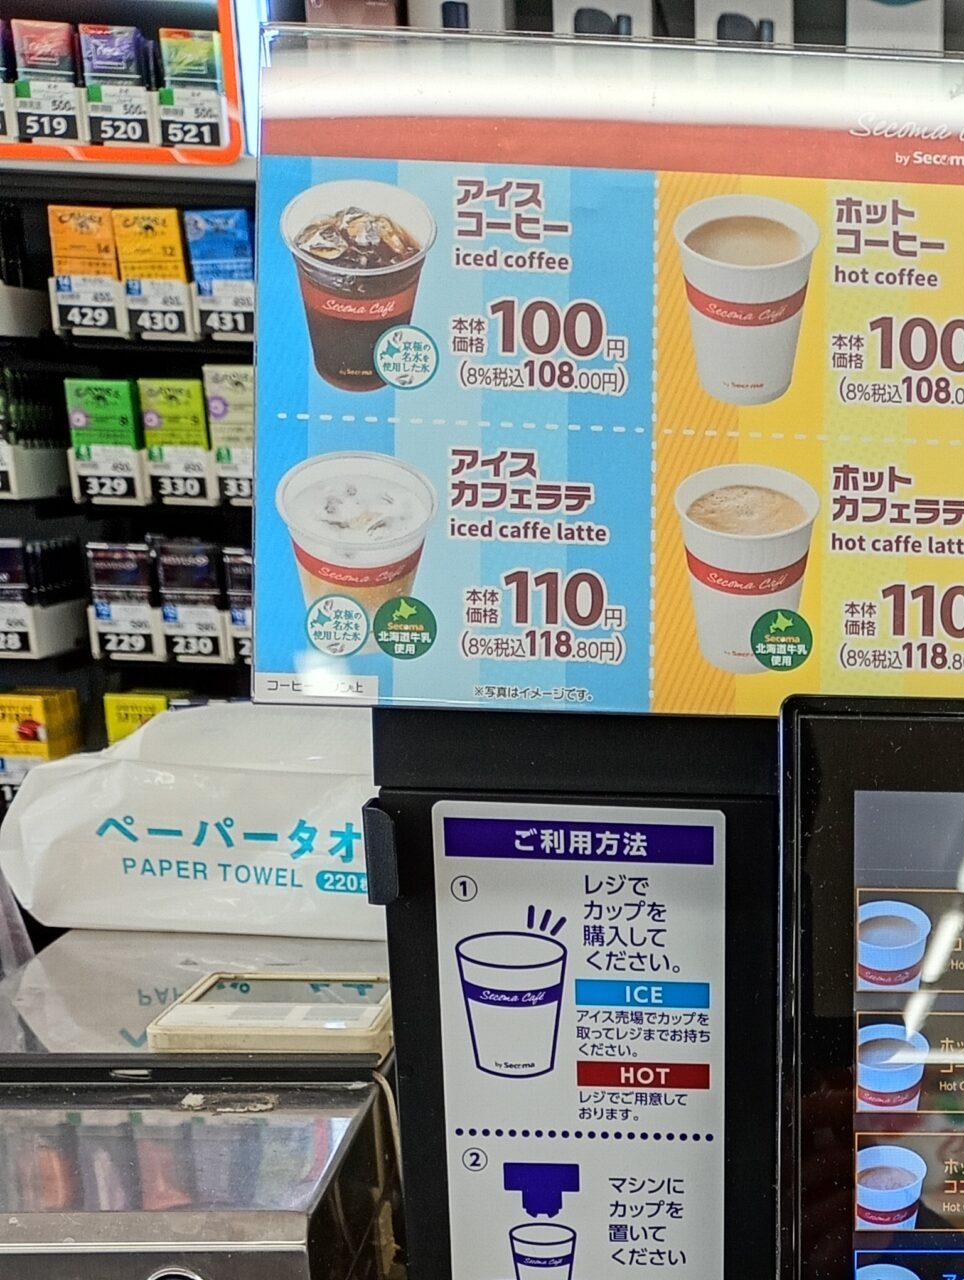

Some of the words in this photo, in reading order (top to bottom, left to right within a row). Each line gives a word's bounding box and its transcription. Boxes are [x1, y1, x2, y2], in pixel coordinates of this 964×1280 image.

[26, 117, 67, 135] 519
[101, 121, 141, 139] 520
[168, 124, 212, 143] 521
[850, 112, 952, 140] Secoma
[896, 153, 910, 165] by
[457, 179, 542, 208] アイス
[836, 198, 915, 225] ホット
[457, 211, 569, 240] コーヒー
[836, 229, 945, 257] コーヒー
[455, 248, 498, 267] iced
[504, 249, 570, 271] coffee
[834, 266, 869, 284] hot
[875, 268, 938, 286] coffee
[67, 308, 108, 326] 429
[137, 312, 179, 329] 430
[206, 313, 245, 331] 431
[452, 318, 485, 334] 本体
[451, 449, 537, 478] アイス
[86, 478, 127, 495] 329
[159, 478, 199, 496] 330
[833, 465, 912, 492] ホット
[451, 482, 592, 511] カフェラテ
[450, 518, 493, 538] iced
[499, 520, 550, 541] caffe
[557, 521, 607, 541] latte
[831, 533, 866, 552] hot
[871, 535, 922, 553] caffe
[466, 590, 499, 605] 本体
[105, 634, 146, 652] 229
[173, 637, 213, 654] 230
[378, 632, 431, 642] 北海道牛乳
[394, 644, 415, 654] 使用
[96, 816, 362, 864] ペーパータオ
[514, 829, 648, 856] ご利用方法
[122, 858, 208, 880] PAPER
[218, 863, 304, 888] TOWEL
[584, 875, 650, 895] レジで
[584, 901, 667, 922] カップを
[583, 926, 667, 947] 購入して
[585, 951, 680, 973] ください。
[626, 986, 663, 1004] ICE
[576, 1010, 710, 1026] アイス売場でカップを
[576, 1027, 710, 1042] 取ってレジまでお持ち
[578, 1044, 638, 1057] ください。
[620, 1067, 670, 1084] HOT
[939, 1080, 956, 1091] Hot
[579, 1091, 687, 1106] レジでご用意して
[579, 1107, 639, 1121] おります。
[608, 1177, 685, 1195] マシンに
[609, 1201, 684, 1218] カップを
[942, 1202, 960, 1212] Hot
[608, 1225, 666, 1242] 置いて
[610, 1248, 687, 1266] ください
